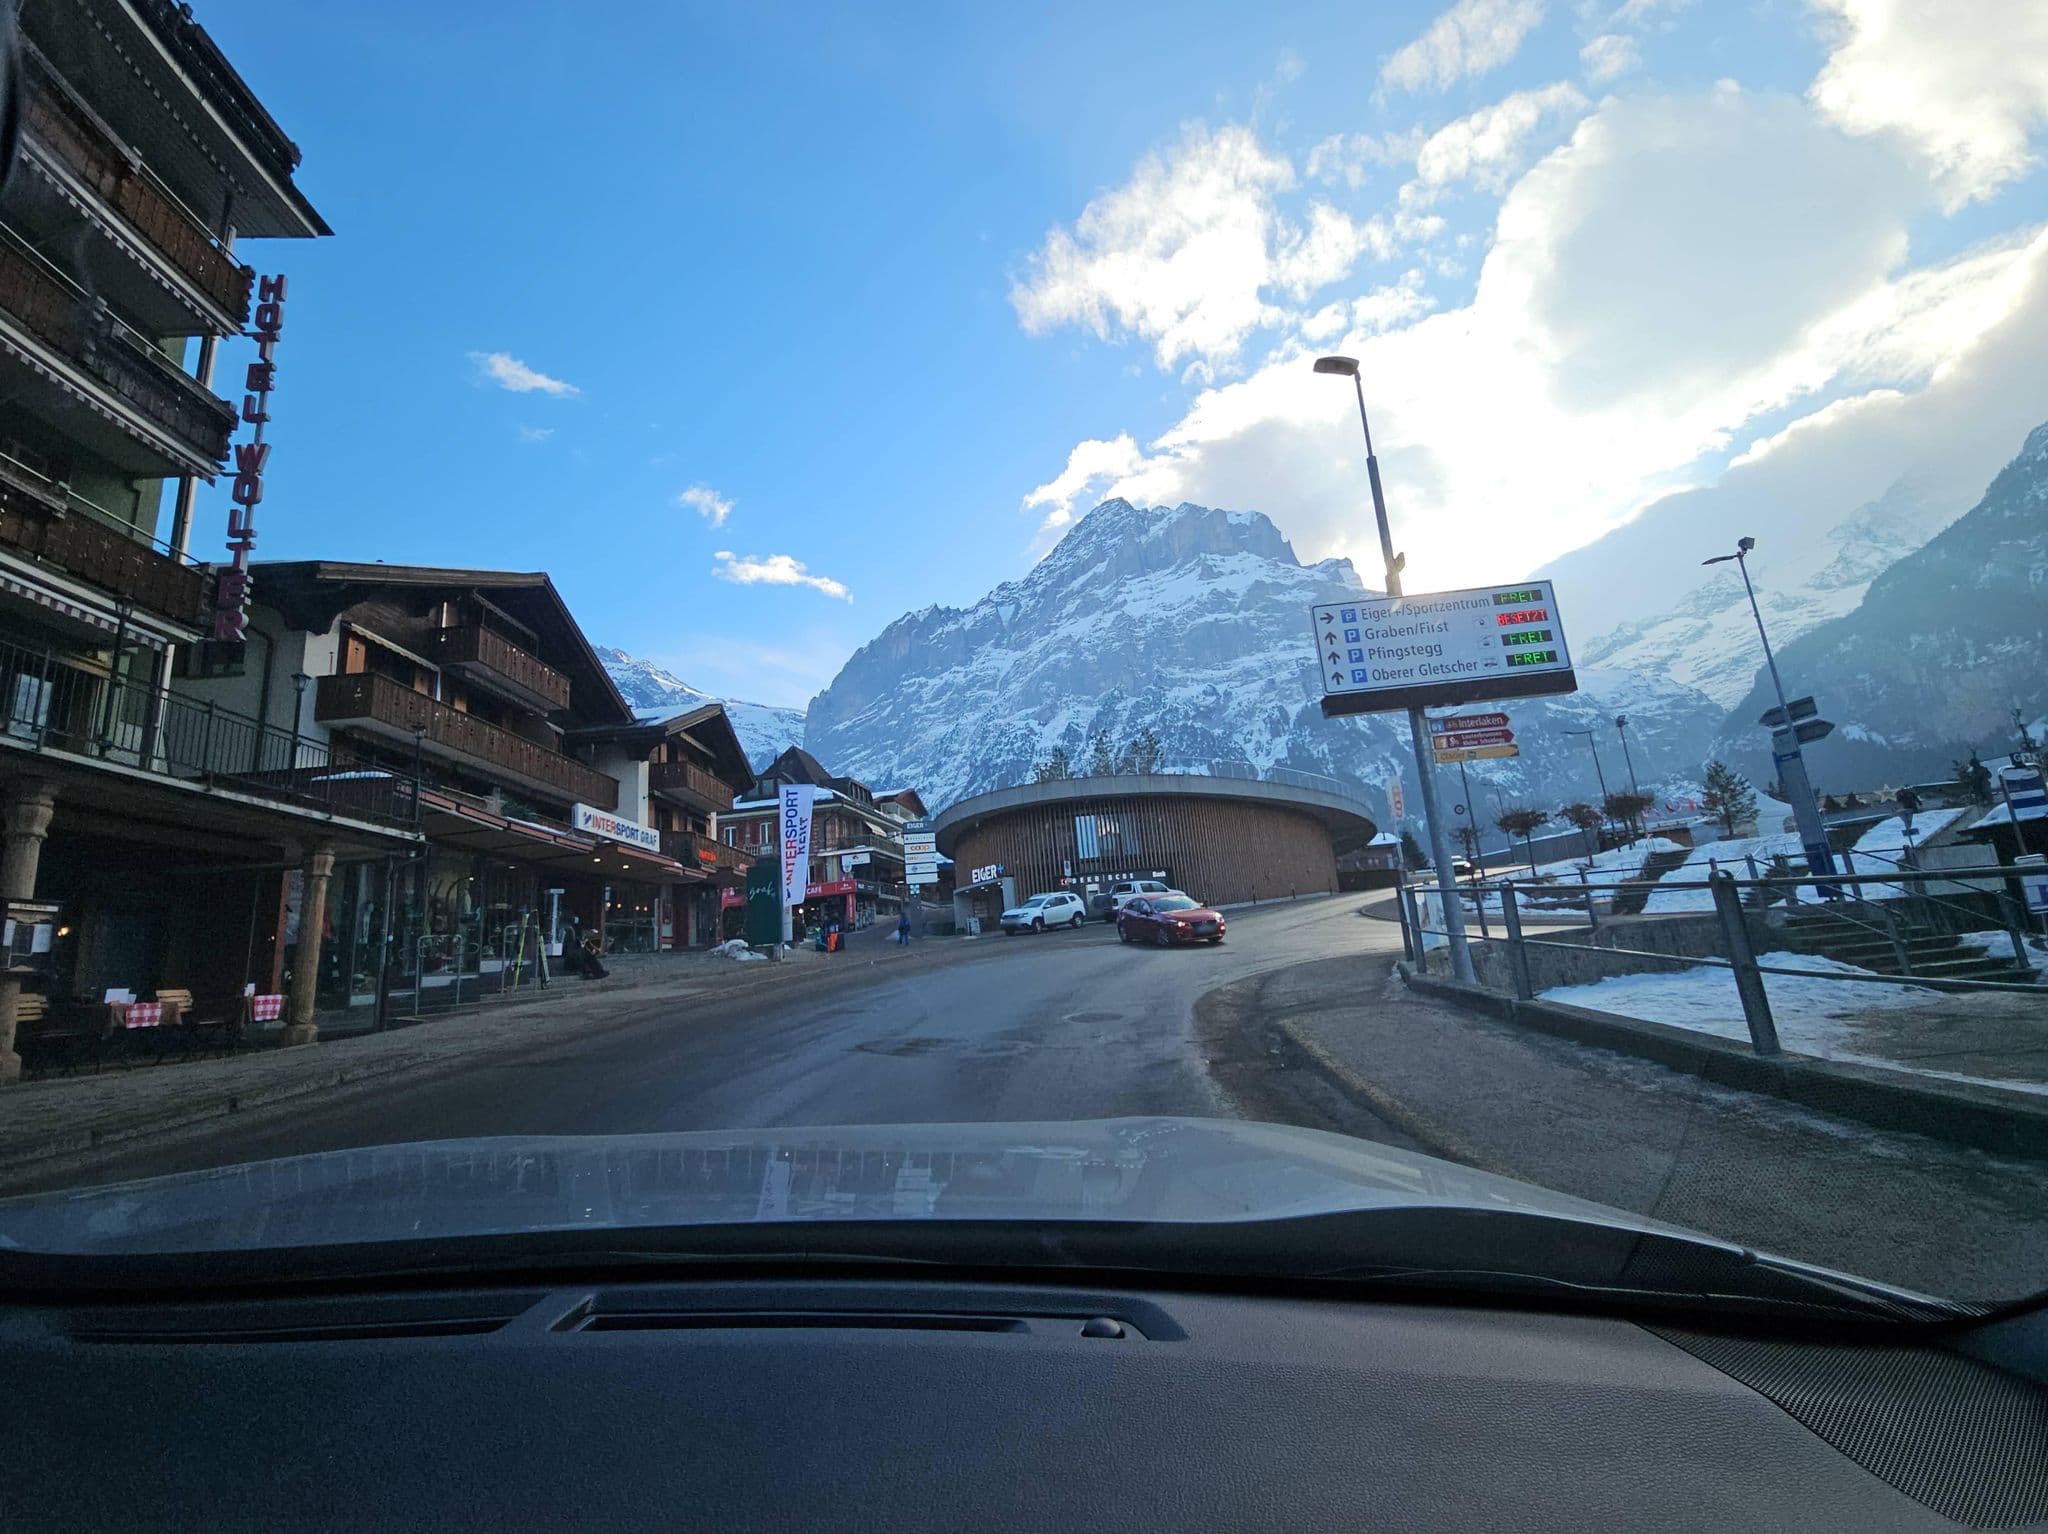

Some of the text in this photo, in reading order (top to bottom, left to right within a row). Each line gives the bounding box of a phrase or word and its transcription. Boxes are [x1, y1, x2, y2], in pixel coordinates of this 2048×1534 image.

[242, 274, 288, 425] HOTEL
[213, 442, 271, 642] WOLTER
[1500, 591, 1535, 603] FREI
[1361, 607, 1391, 622] Eiger
[1364, 622, 1449, 640] Graben/First
[1509, 631, 1544, 644] FREI
[1368, 643, 1443, 660] Pfingstegg
[1372, 667, 1414, 681] Oberer
[1418, 660, 1478, 676] Gletscher
[1458, 716, 1504, 728] Interlaken
[591, 814, 657, 847] INTERSPORT GRAF
